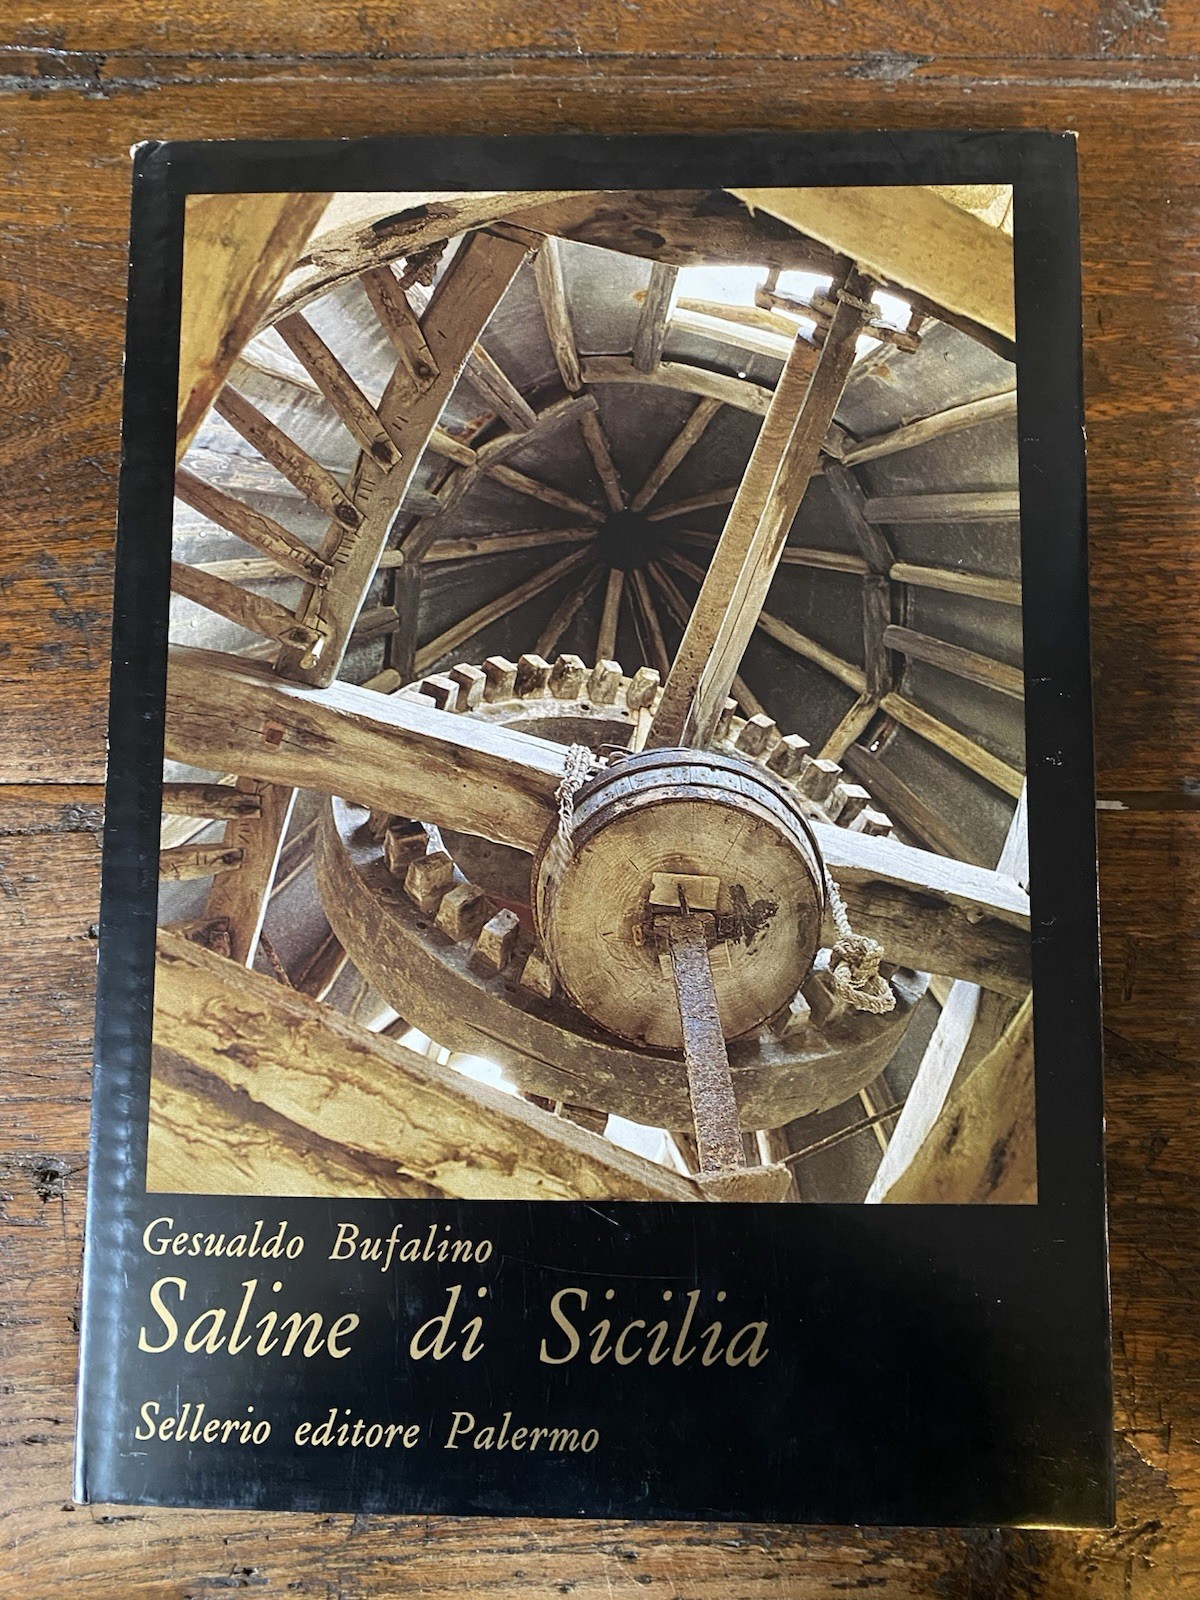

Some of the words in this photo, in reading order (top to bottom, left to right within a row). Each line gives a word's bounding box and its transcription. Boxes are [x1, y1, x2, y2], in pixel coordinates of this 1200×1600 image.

[142, 1217, 305, 1260] Gesualdo
[329, 1222, 493, 1273] Bufalino
[137, 1276, 360, 1359] Saline
[409, 1284, 488, 1362] di
[539, 1287, 768, 1367] Sicilia
[135, 1401, 271, 1445] Sellerio
[294, 1408, 420, 1449] editore
[444, 1411, 600, 1453] Palermo
